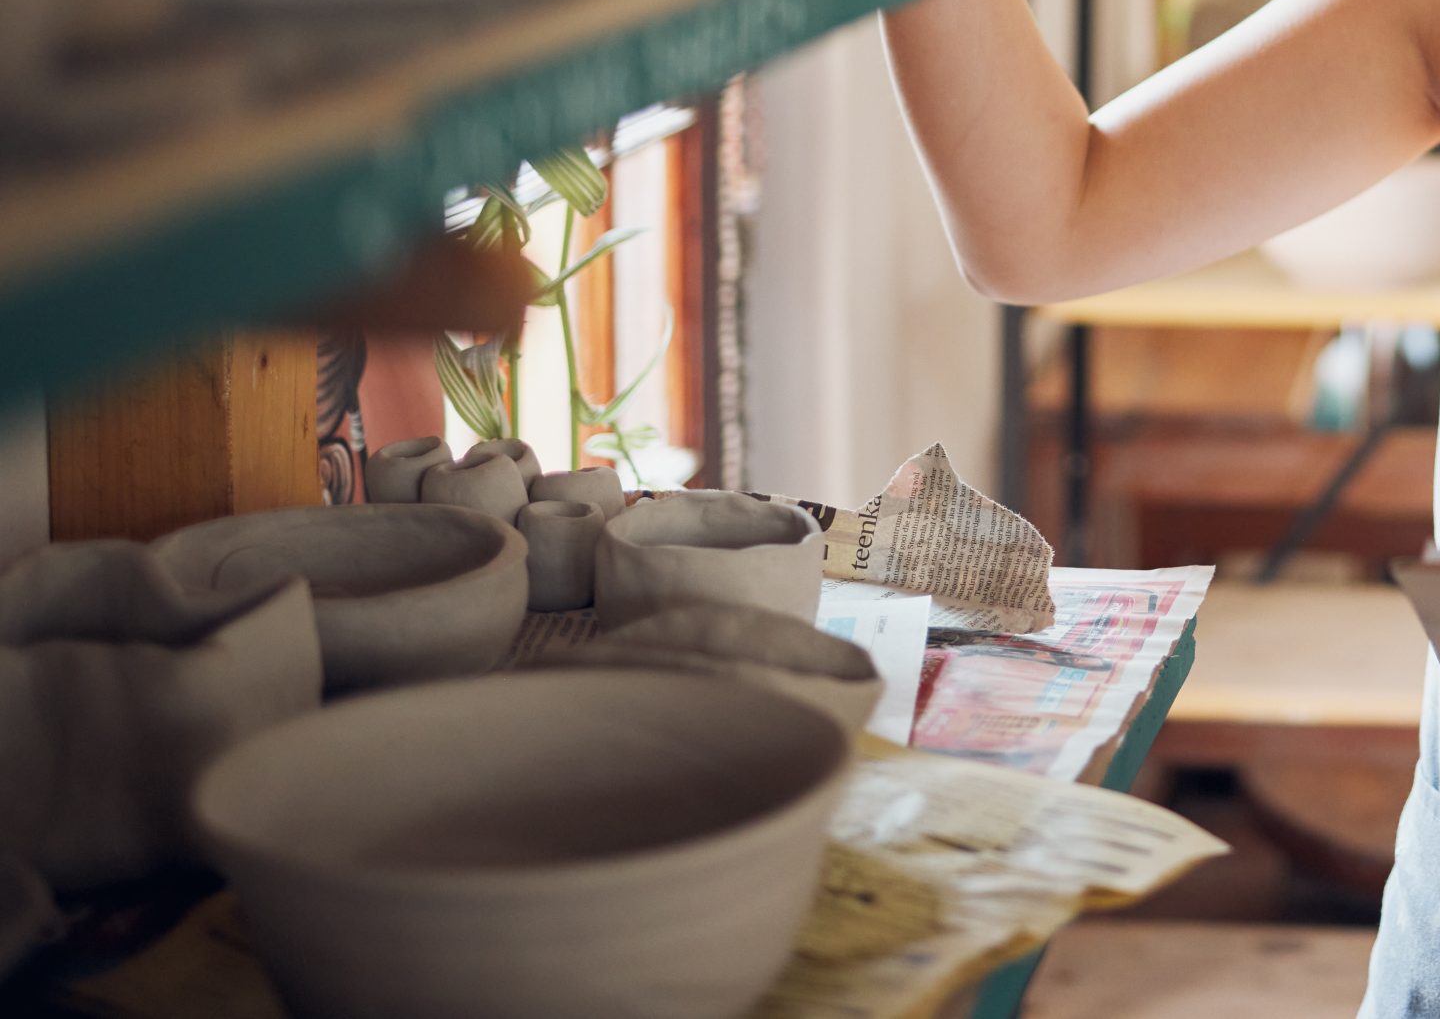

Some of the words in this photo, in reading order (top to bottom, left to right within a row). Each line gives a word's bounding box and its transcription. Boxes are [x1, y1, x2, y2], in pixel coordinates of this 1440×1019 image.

[906, 487, 918, 519] regering
[940, 508, 948, 523] van
[953, 499, 966, 535] inentings
[902, 520, 911, 533] die
[910, 549, 922, 572] Sizwe
[923, 467, 937, 520] woordvoerder
[918, 567, 926, 581] die
[922, 521, 937, 566] vakverbond
[936, 468, 945, 491] gister
[937, 524, 945, 538] pas
[899, 534, 908, 551] gooi
[931, 539, 942, 566] stadige
[947, 535, 961, 565] Genoeg
[953, 551, 965, 571] hulle
[960, 520, 971, 550] verdere
[1027, 542, 1035, 556] nie
[890, 551, 904, 585] Intussen
[902, 551, 913, 571] John
[927, 567, 935, 580] die
[978, 545, 994, 576] Dinsdag
[988, 548, 1001, 579] mediese
[998, 555, 1007, 569] die
[1005, 558, 1021, 594] ekonomie
[1017, 545, 1026, 558] nie
[1034, 569, 1046, 584] kan
[1041, 555, 1049, 569] nie
[973, 578, 985, 597] Teen
